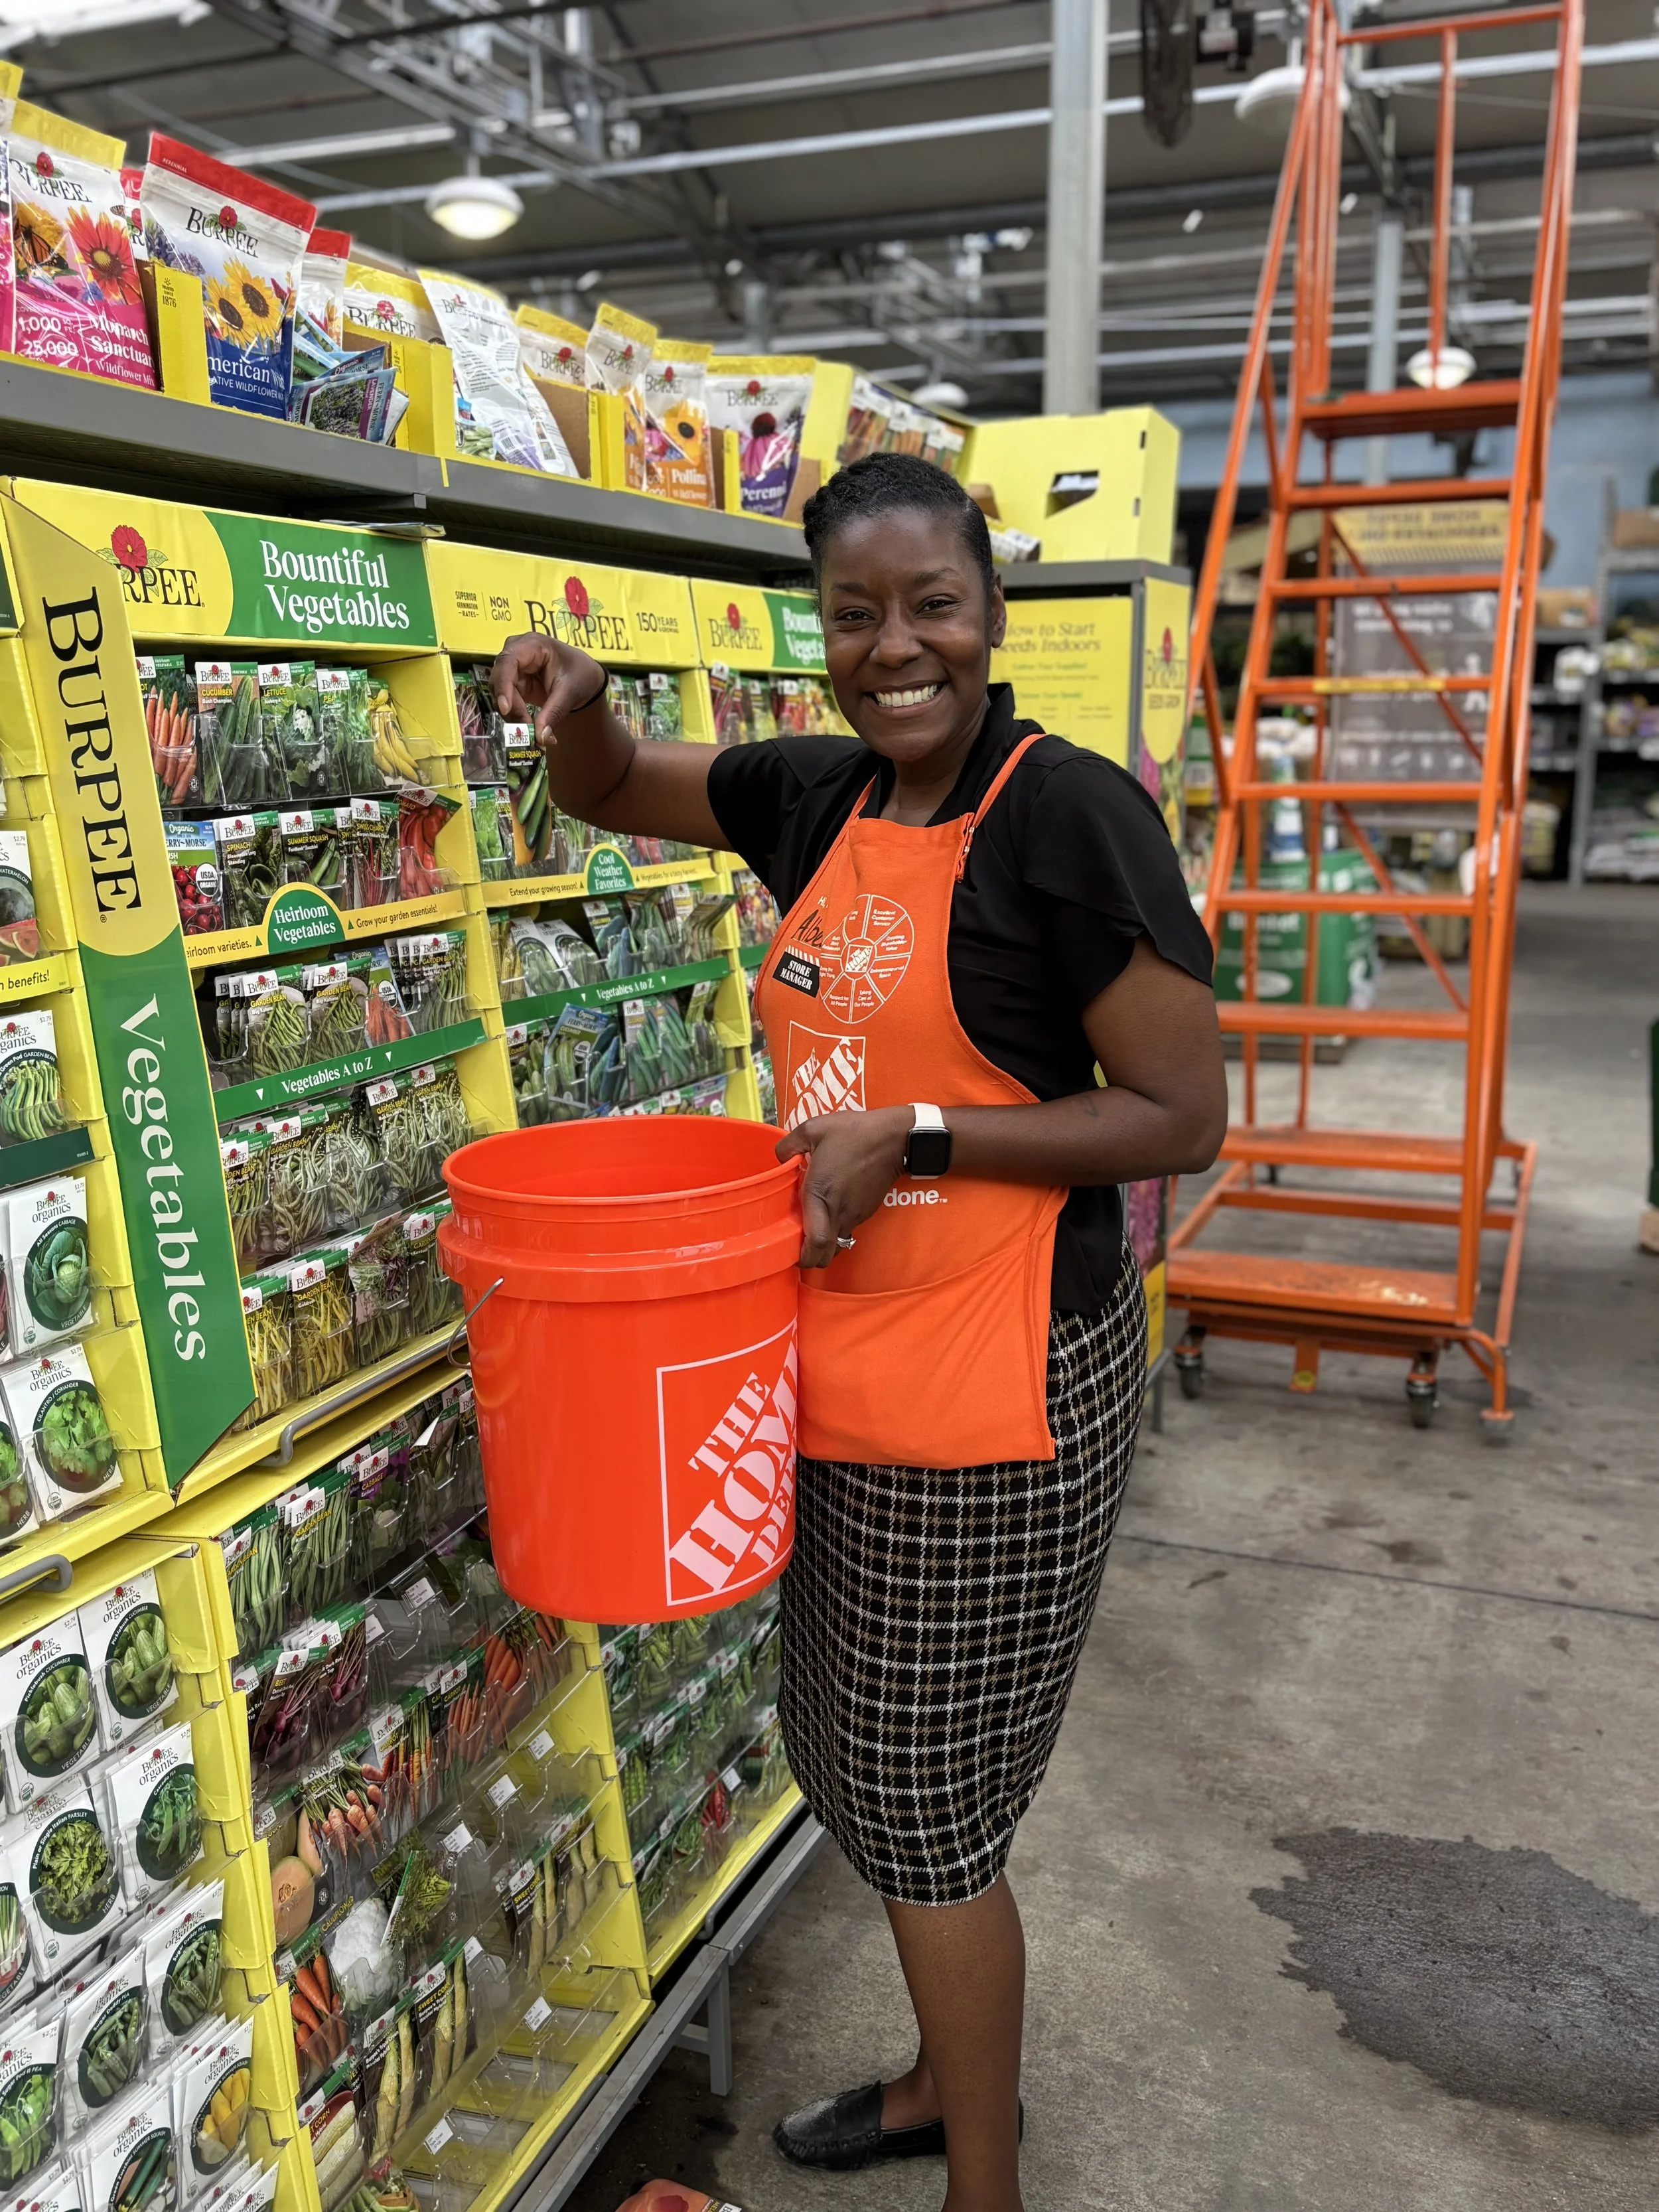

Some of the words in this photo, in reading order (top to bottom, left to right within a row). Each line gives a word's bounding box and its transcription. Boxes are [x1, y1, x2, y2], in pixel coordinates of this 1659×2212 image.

[186, 206, 259, 258] BURPEE
[162, 295, 177, 308] 1876
[92, 336, 155, 370] Sanctuar
[96, 360, 142, 383] Wildflower
[207, 356, 270, 383] merican
[259, 540, 390, 589] Bountiful
[123, 563, 201, 607] RPEE
[455, 591, 477, 602] SUPERIOR
[490, 597, 509, 609] NON
[263, 584, 410, 634] Vegetables
[491, 609, 512, 622] GMO
[524, 599, 631, 651] BURPEE
[636, 612, 657, 632] 150
[657, 617, 678, 627] YEARS
[708, 618, 764, 650] BURPEE
[201, 670, 231, 682] BURPEE
[262, 671, 290, 684] BURPEE
[322, 679, 348, 690] BURPEE
[202, 688, 233, 697] CUCUMBER
[264, 688, 287, 697] LETTUCE
[42, 587, 142, 913] BURPEE
[356, 807, 380, 820] BURPEE
[169, 824, 194, 835] Organic
[224, 825, 253, 838] BURPEE
[286, 820, 313, 832] BURPEE
[226, 842, 251, 852] SPINACH
[287, 836, 309, 846] SUMMER
[309, 834, 328, 844] SQUASH
[599, 853, 615, 864] Cool
[200, 871, 215, 879] USDA
[594, 865, 623, 877] Weather
[510, 887, 528, 897] Extend
[541, 883, 561, 895] growing
[595, 876, 626, 891] Favorites
[274, 903, 329, 925] Heirloom
[356, 917, 374, 929] Grow
[375, 915, 390, 928] your
[391, 910, 409, 924] garden
[410, 904, 438, 920] essentials!
[273, 920, 336, 946] Vegetables
[187, 946, 215, 959] eirloom
[218, 940, 252, 956] varieties.
[423, 942, 448, 954] BURPEE
[317, 970, 347, 986] BURPEE
[788, 960, 812, 978] STORE
[8, 970, 50, 990] benefits!
[248, 980, 277, 994] BURPEE
[780, 968, 813, 990] MANAGER
[250, 996, 274, 1007] GARDEN
[273, 993, 287, 1003] BEAN
[316, 986, 340, 997] GARDEN
[596, 985, 633, 1001] Vegetables
[281, 1068, 341, 1094] Vegetables
[342, 1065, 352, 1077] A
[352, 1062, 364, 1073] to
[366, 1057, 374, 1070] Z
[792, 1047, 820, 1096] THE
[372, 1088, 397, 1103] BURPEE
[273, 1127, 300, 1142] BURPEE
[120, 993, 207, 1361] Vegetables
[36, 1194, 67, 1212] BURPEE
[32, 1202, 72, 1224] organics
[297, 1270, 325, 1290] BURPEE
[297, 1288, 320, 1301] GARDEN
[60, 1305, 88, 1328] VEGETABLE
[29, 1366, 72, 1392] organics
[31, 1361, 64, 1380] BURPEE
[36, 1396, 53, 1422] CILANTRO
[687, 1371, 772, 1479] THE
[103, 1465, 116, 1482] HERB
[363, 1457, 387, 1478] BURPEE
[670, 1339, 797, 1591] HOM
[362, 1472, 384, 1491] CABBAGE
[17, 1511, 31, 1528] HERB
[296, 1499, 324, 1524] BURPEE
[751, 1453, 796, 1567] DEP
[296, 1518, 317, 1536] GARDEN
[317, 1509, 332, 1522] BEAN
[103, 1591, 142, 1623] organics
[105, 1585, 135, 1612] BURPEE
[128, 1605, 149, 1619] CUCUMBER
[64, 1616, 76, 1629] $2.79
[16, 1643, 62, 1680] organics
[19, 1638, 55, 1667] BURPEE
[45, 1657, 71, 1672] CUCUMBER
[275, 1678, 287, 1687] BEET
[444, 1686, 462, 1702] CARROT
[61, 1736, 92, 1771] VEGETABLE
[139, 1753, 180, 1787] organics
[102, 1893, 116, 1913] HERB
[321, 1895, 354, 1932] CAULIFLOWER
[417, 1992, 437, 2012] SWEET
[42, 2026, 57, 2039] $2.79
[315, 2108, 331, 2128] CORN
[113, 2119, 153, 2158] organics
